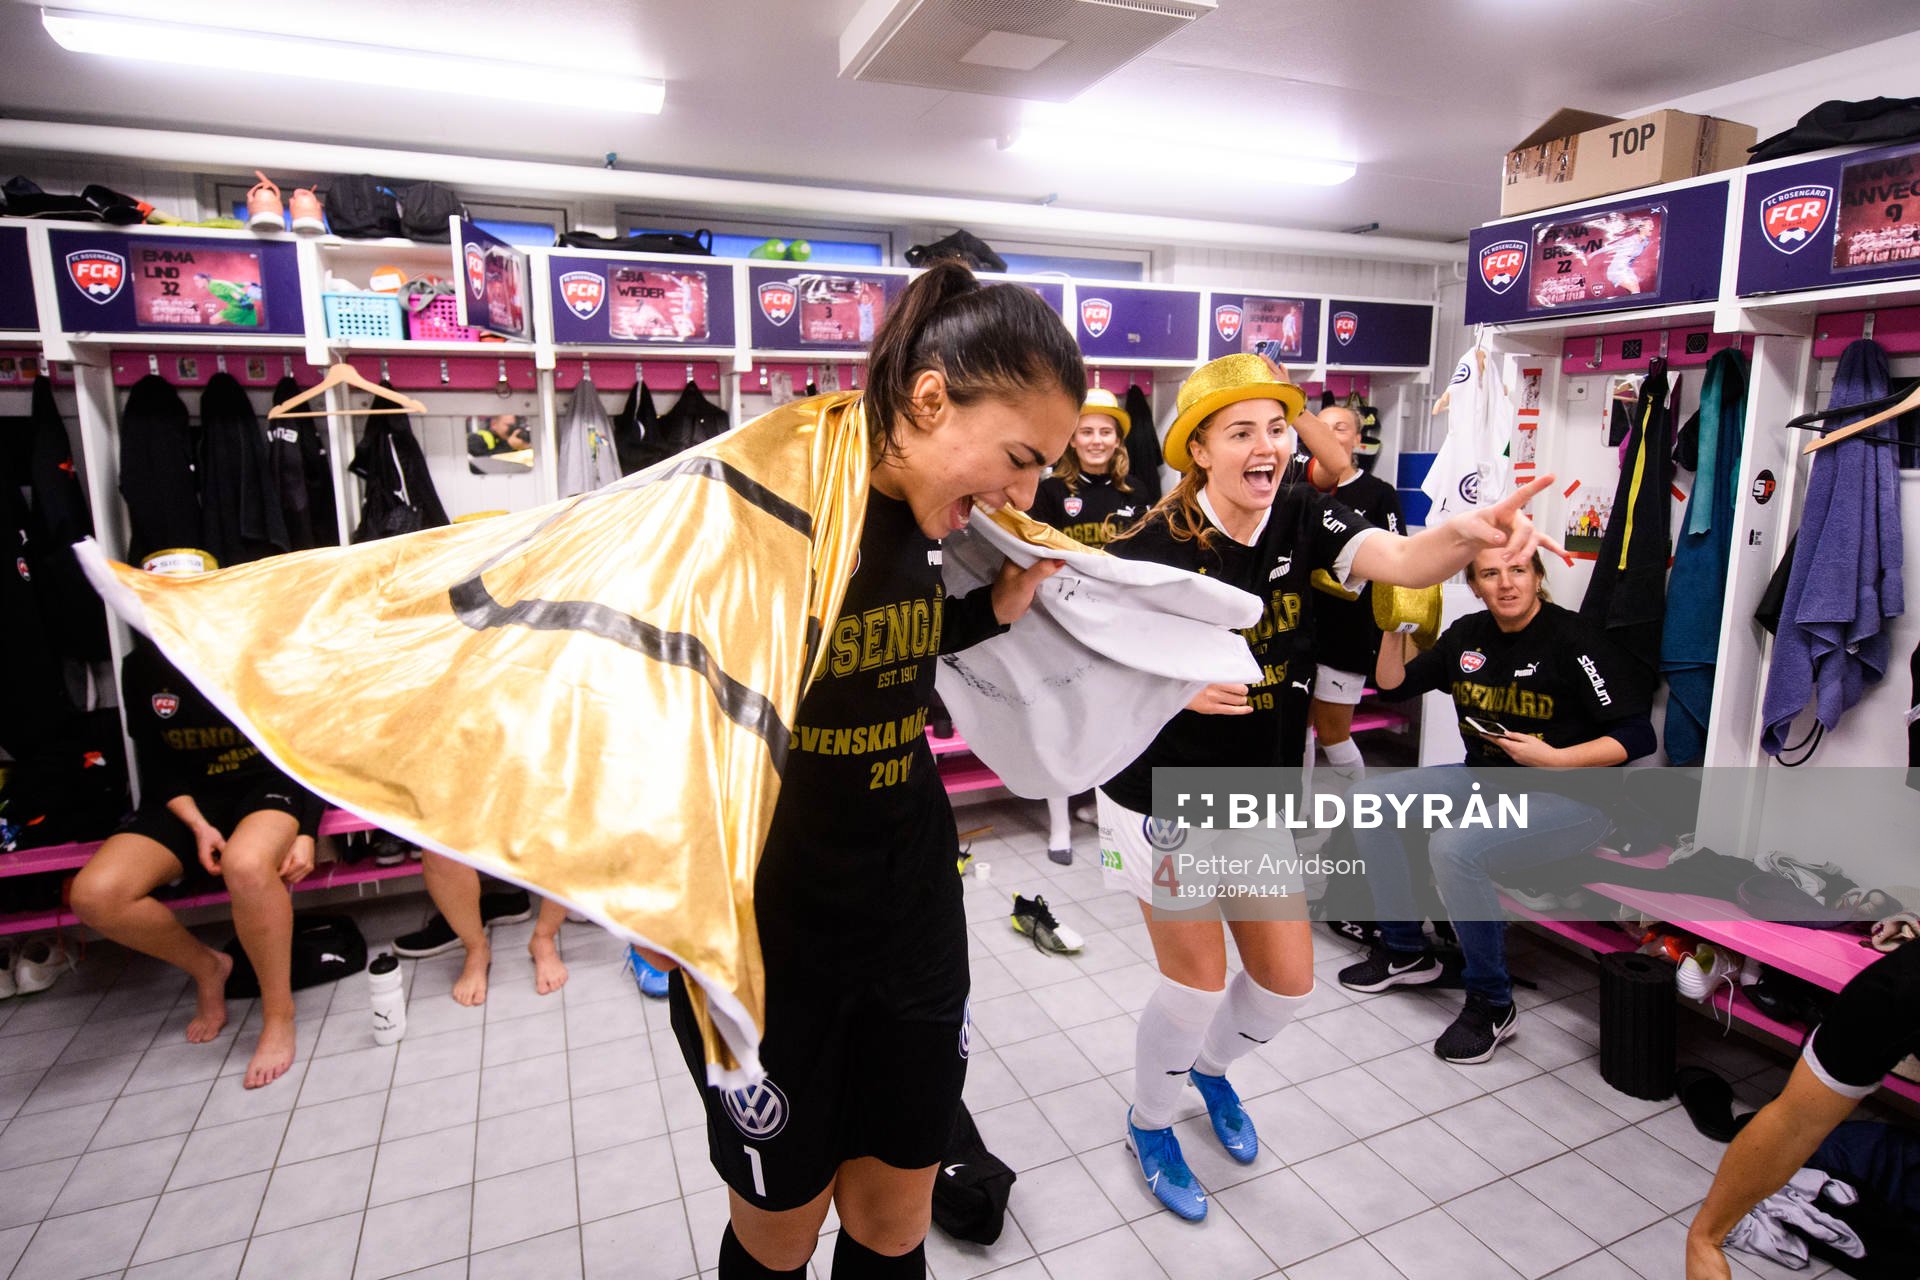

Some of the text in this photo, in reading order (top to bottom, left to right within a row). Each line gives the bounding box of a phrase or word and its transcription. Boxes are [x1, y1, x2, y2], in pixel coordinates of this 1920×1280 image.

[1609, 123, 1655, 158] TOP
[1769, 201, 1821, 224] FCR
[1886, 204, 1902, 222] 9
[143, 250, 195, 264] EMMA
[1486, 253, 1519, 270] FCR
[77, 263, 117, 278] FCR
[144, 266, 179, 278] LIND
[1557, 260, 1572, 274] 22
[161, 281, 180, 296] 32
[567, 284, 598, 296] FCR
[617, 285, 665, 298] WIEDER
[764, 293, 791, 305] FCR
[1219, 314, 1239, 324] FCR
[1337, 320, 1354, 329] FCR
[1753, 480, 1776, 496] SP
[877, 665, 917, 688] EST. 1917
[1577, 655, 1611, 706] stadium
[788, 721, 897, 755] SVENSKA
[1153, 855, 1179, 897] 4
[743, 1144, 766, 1197] 1
